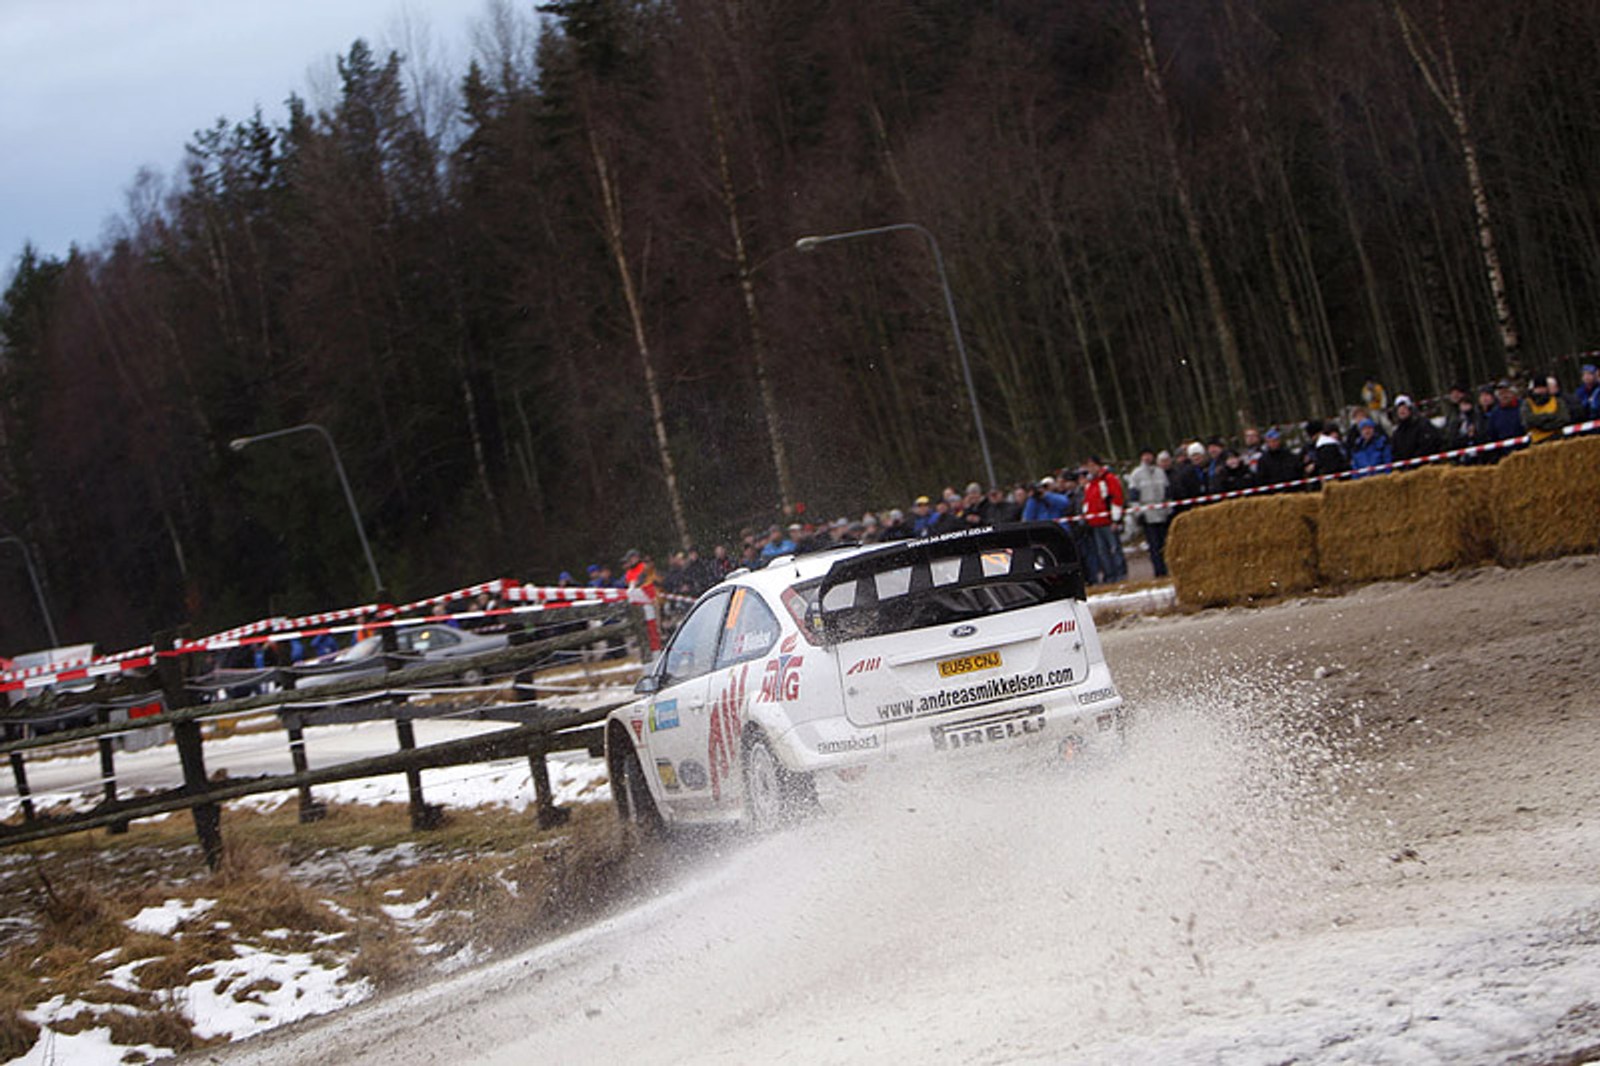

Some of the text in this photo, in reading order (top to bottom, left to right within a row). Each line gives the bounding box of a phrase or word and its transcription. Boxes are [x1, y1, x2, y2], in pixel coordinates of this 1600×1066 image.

[941, 651, 999, 675] EU55 CNJ
[876, 667, 1074, 719] www.andreasmikkelsen.com
